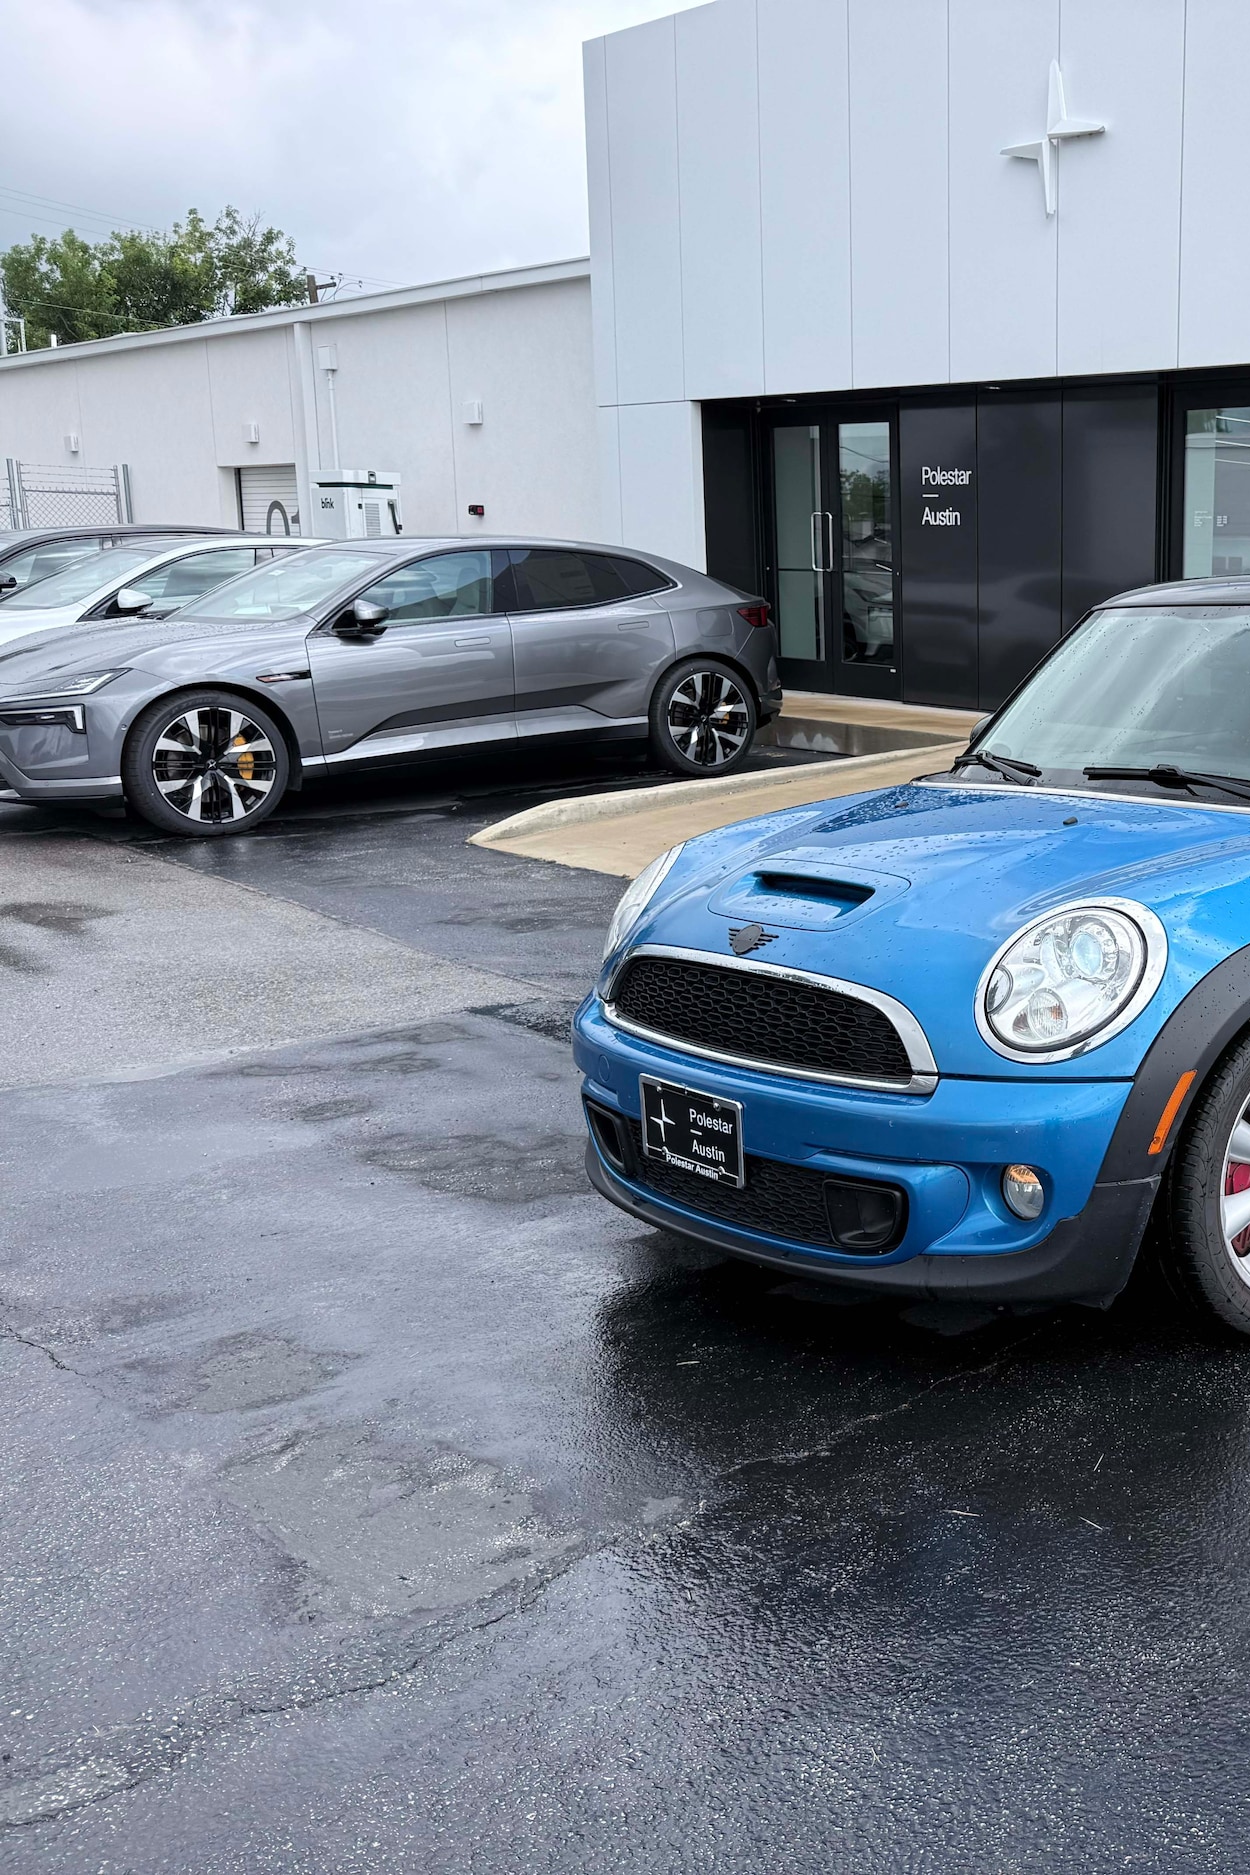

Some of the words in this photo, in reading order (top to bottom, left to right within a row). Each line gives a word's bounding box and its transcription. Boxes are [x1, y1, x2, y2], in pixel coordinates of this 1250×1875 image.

[921, 466, 972, 485] Polestar
[321, 497, 335, 510] blink
[921, 506, 961, 526] Austin
[688, 1107, 733, 1135] Polestar
[691, 1139, 726, 1163] Austin
[665, 1153, 695, 1172] Polestar
[695, 1164, 719, 1181] Austin
